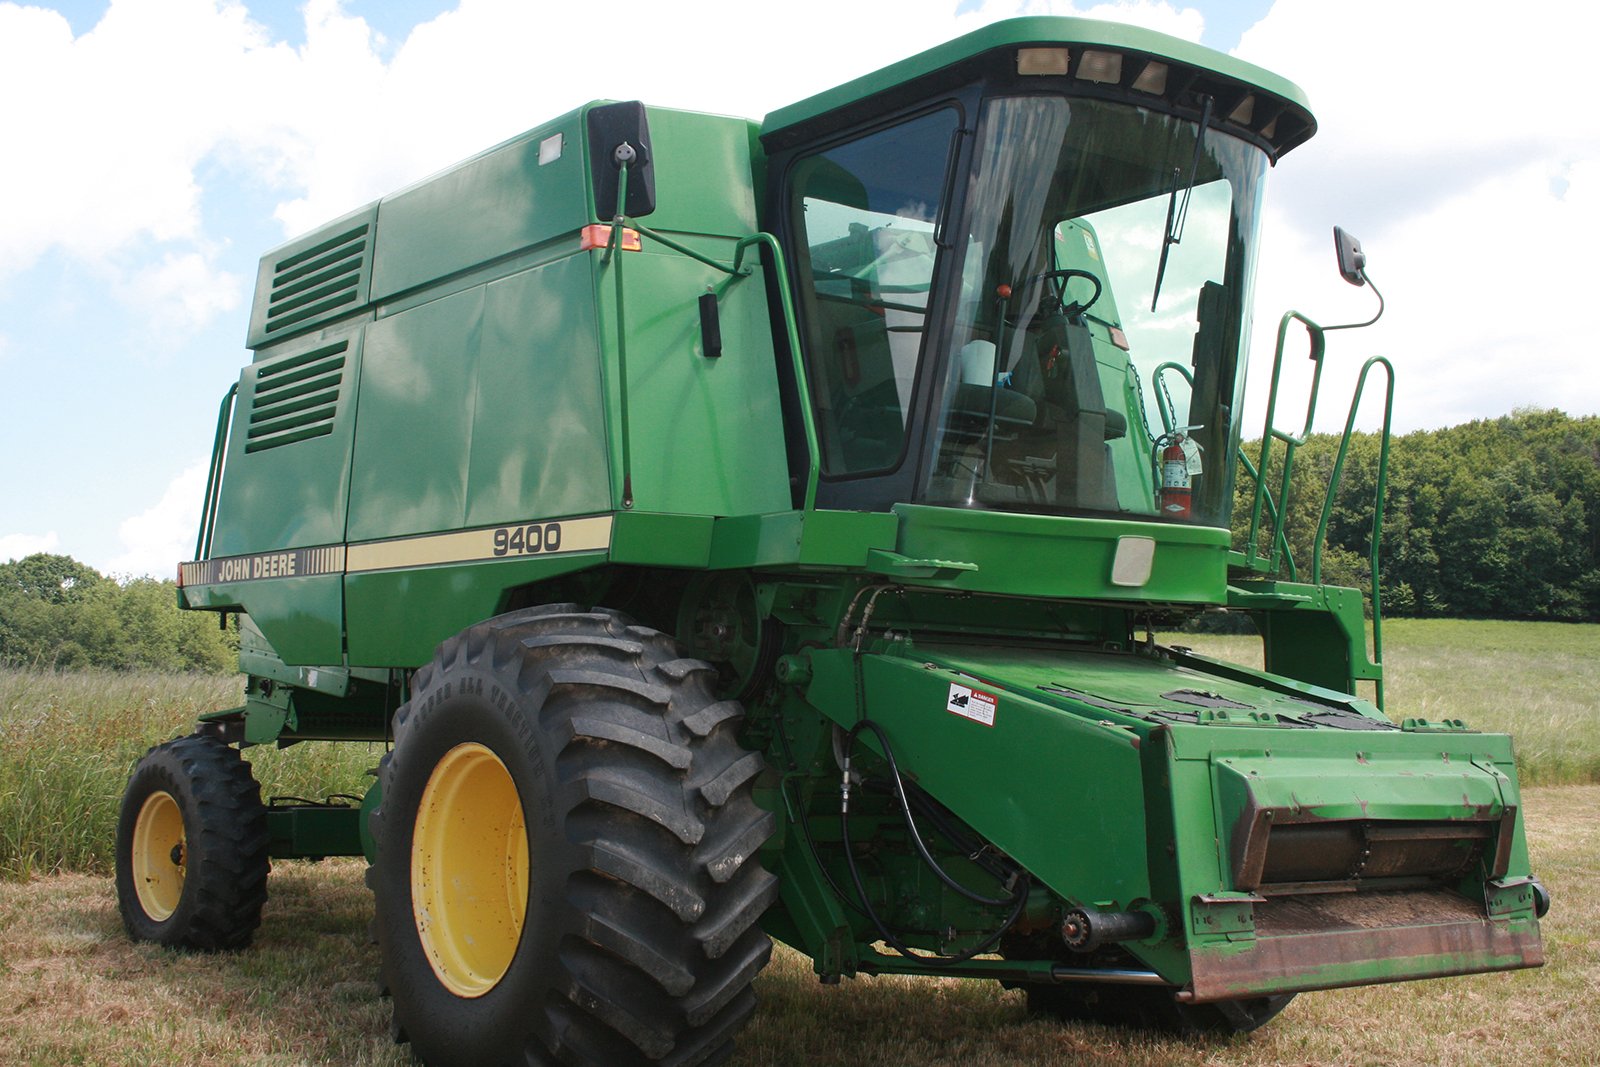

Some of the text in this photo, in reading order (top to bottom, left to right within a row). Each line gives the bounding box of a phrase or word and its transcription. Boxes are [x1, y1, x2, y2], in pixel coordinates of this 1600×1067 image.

[494, 523, 561, 556] 9400
[218, 553, 296, 582] JOHN DEERE
